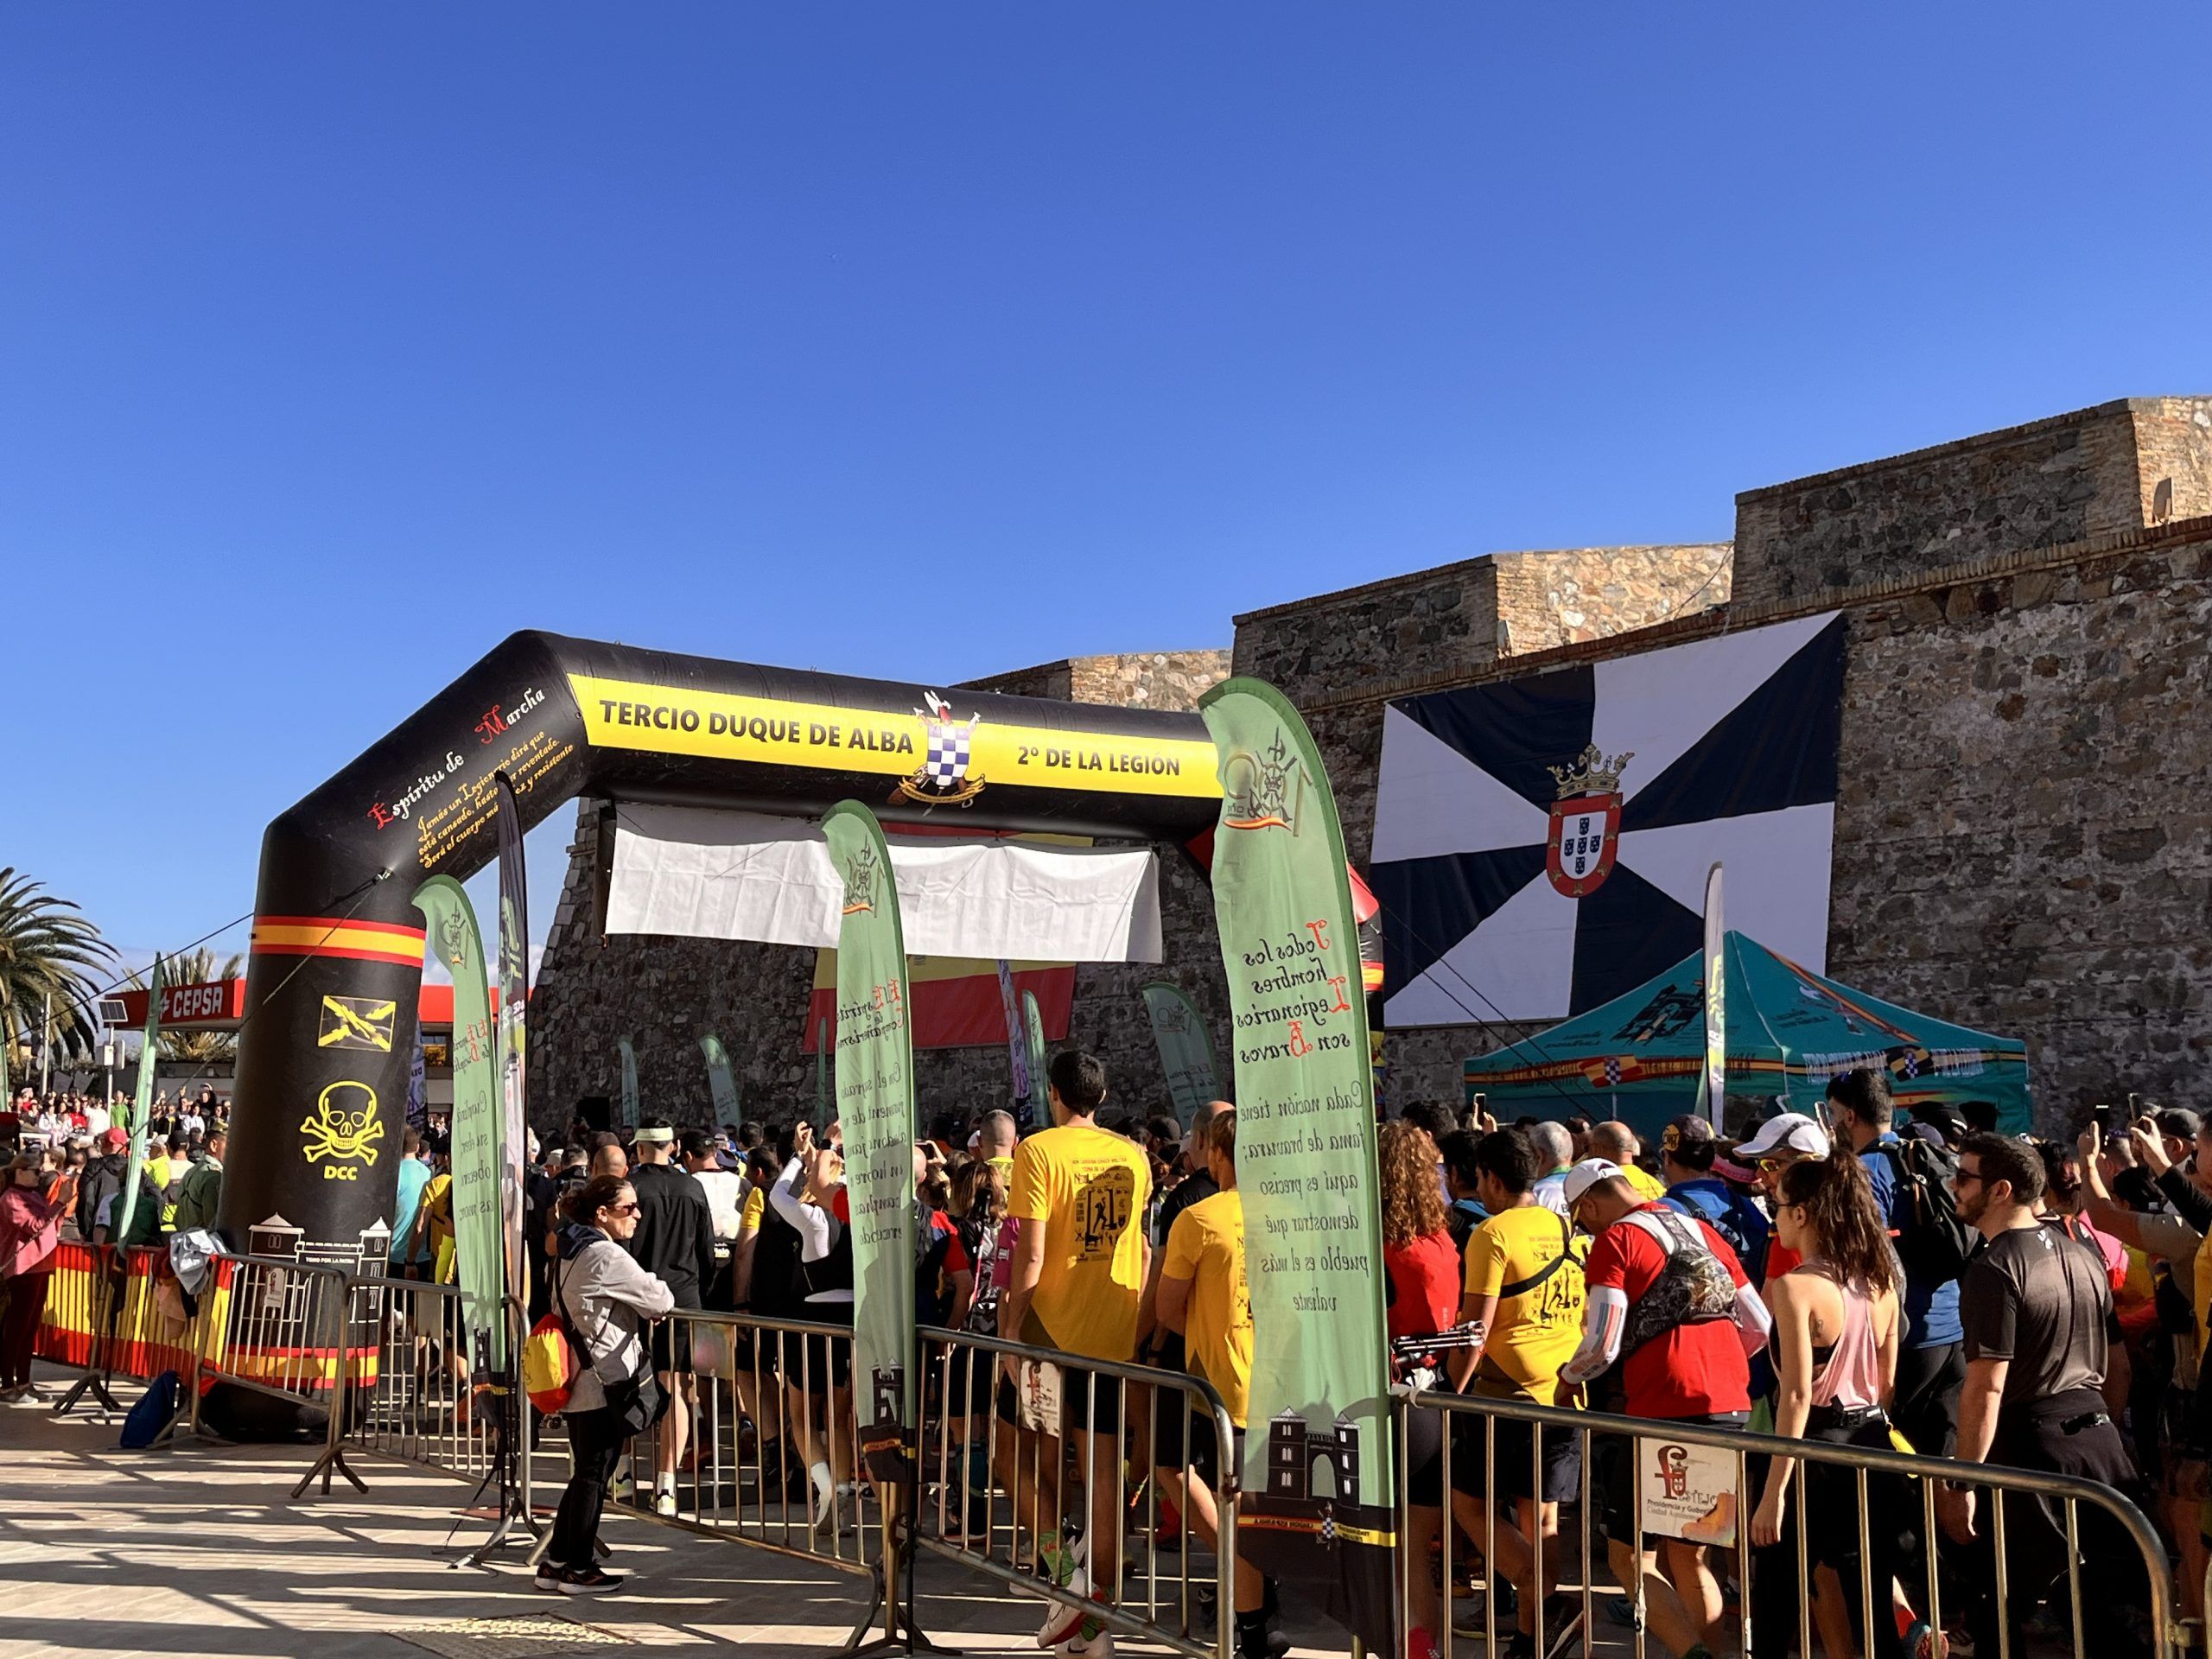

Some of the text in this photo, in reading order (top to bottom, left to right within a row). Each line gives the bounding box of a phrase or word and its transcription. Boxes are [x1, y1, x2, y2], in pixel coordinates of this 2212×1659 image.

[599, 699, 915, 754] TERCIO DUQUE DE ALBA
[367, 688, 546, 830] Espíritu de Marcha
[448, 798, 463, 811] un
[511, 741, 530, 761] dirá
[530, 730, 546, 751] que
[1046, 748, 1071, 769] DE
[1077, 750, 1103, 772] LA
[486, 802, 499, 817] má
[172, 986, 224, 1019] CEPSA
[323, 1165, 359, 1181] DCC
